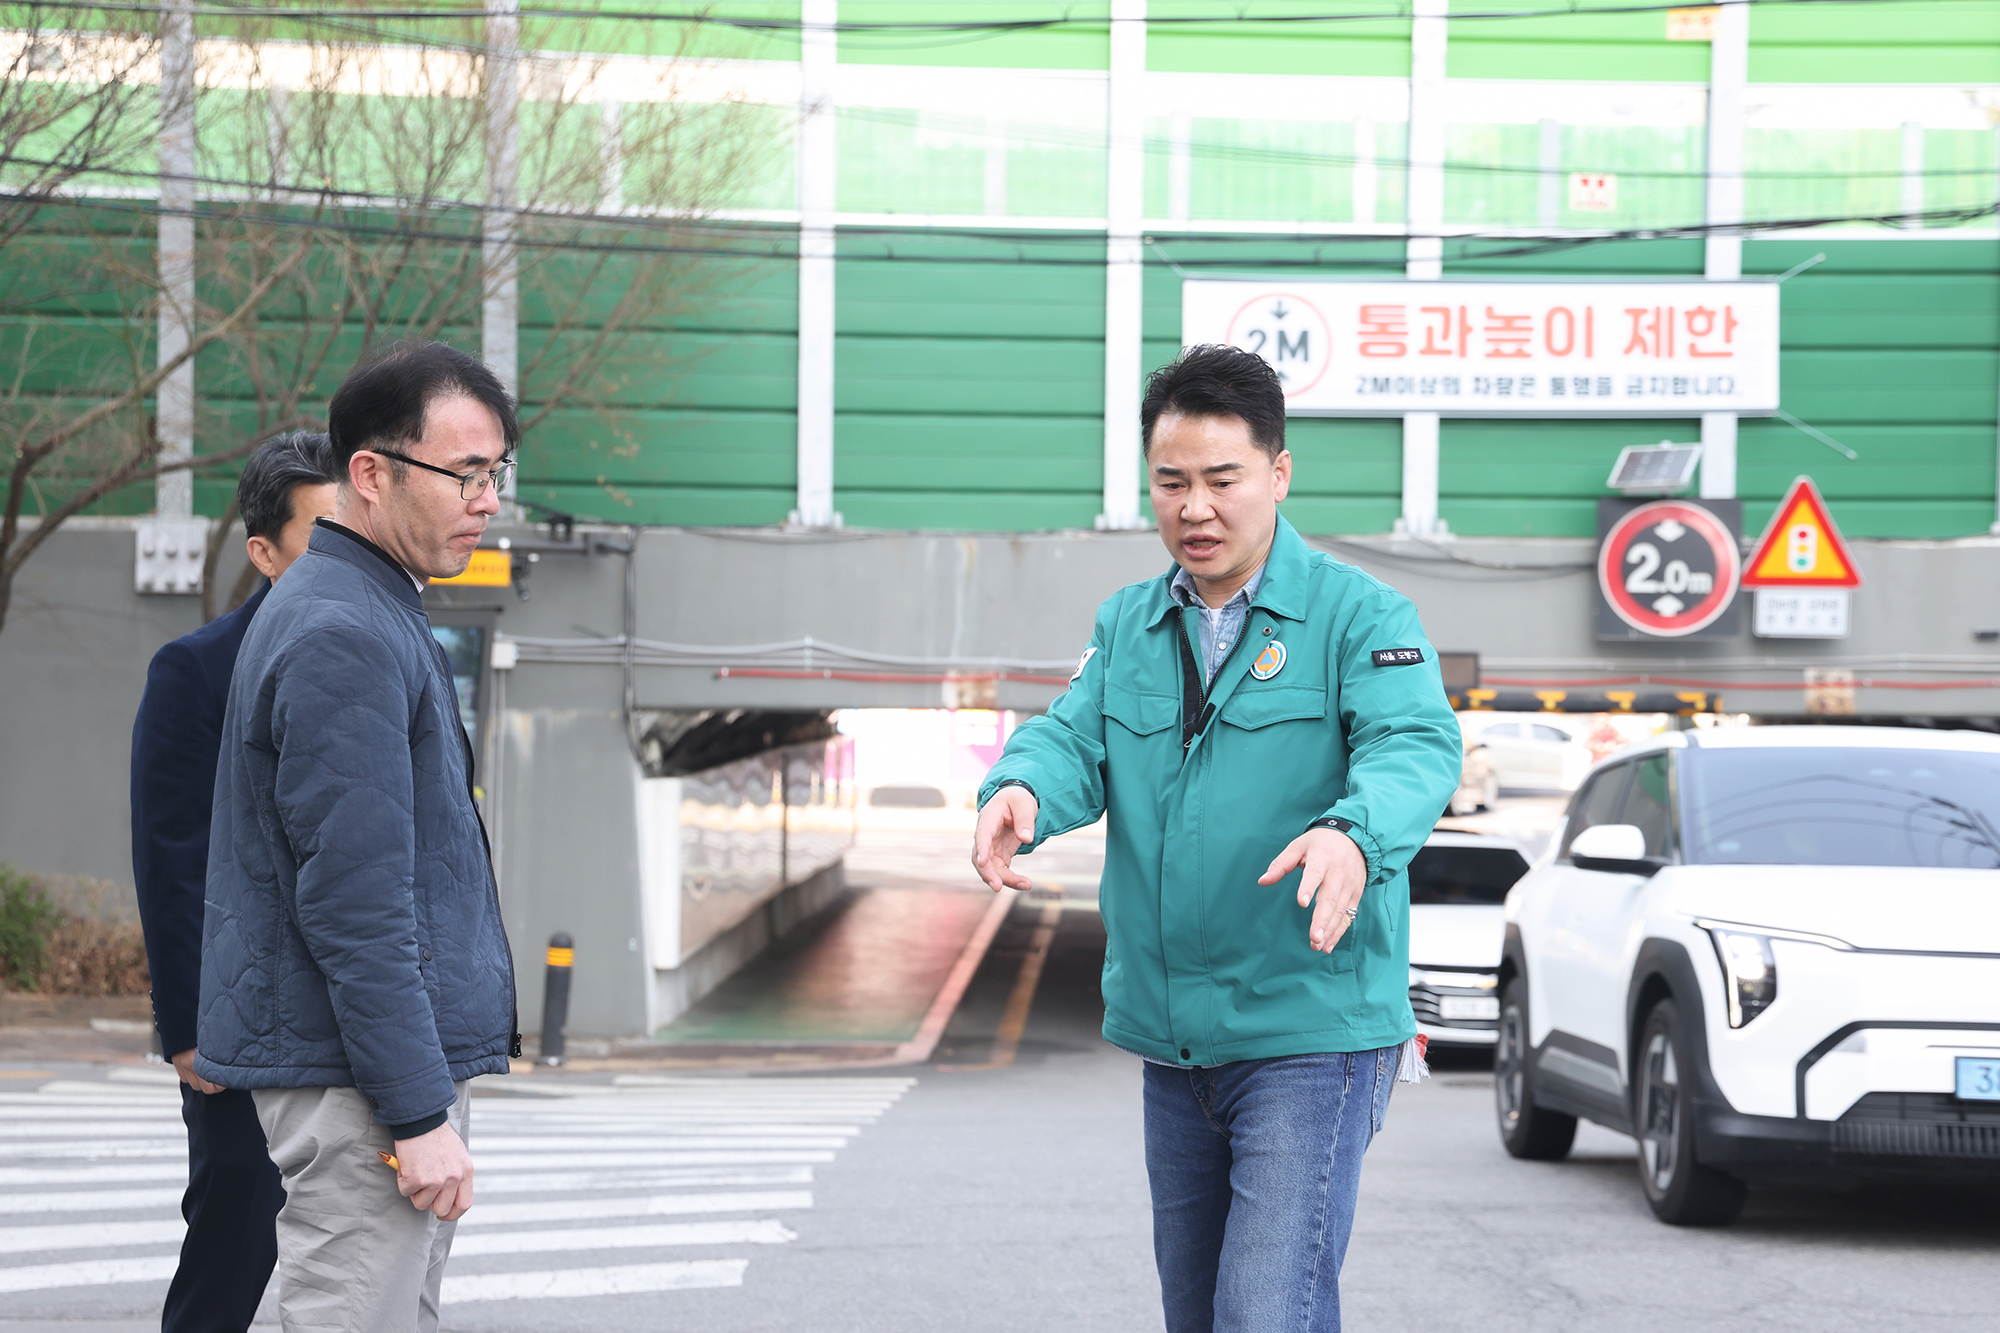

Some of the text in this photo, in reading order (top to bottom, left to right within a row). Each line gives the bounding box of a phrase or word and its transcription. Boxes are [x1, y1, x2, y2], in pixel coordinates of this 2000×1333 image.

[1248, 330, 1309, 362] 2M
[1357, 304, 1739, 359] 통과높이 제한
[1356, 376, 1461, 396] 2M이상의
[1473, 376, 1536, 397] 차량은
[1550, 376, 1612, 397] 통행을
[1625, 542, 1713, 594] 2.0m
[1379, 652, 1396, 662] 서울
[1975, 1065, 2000, 1094] 3
